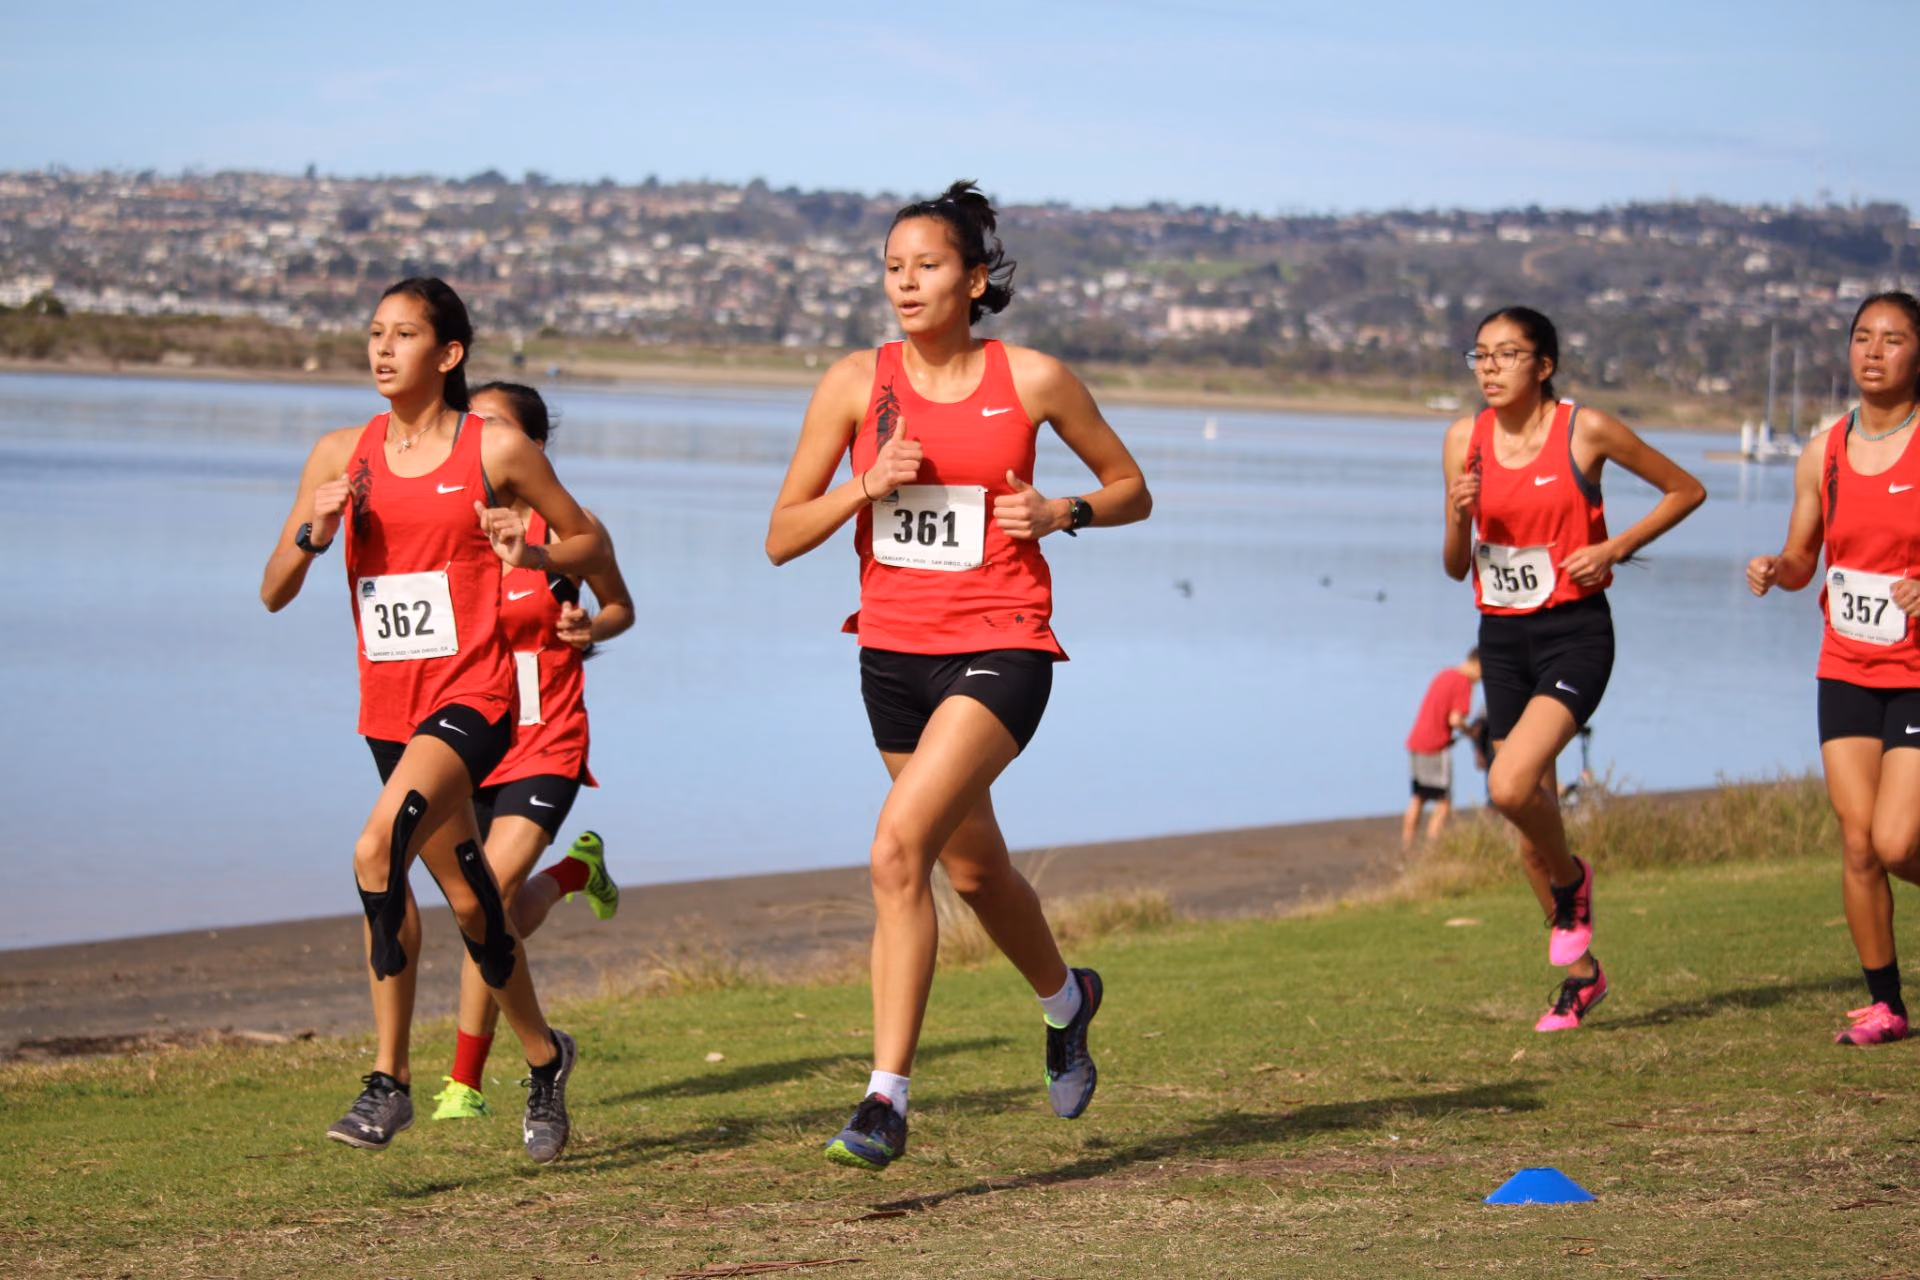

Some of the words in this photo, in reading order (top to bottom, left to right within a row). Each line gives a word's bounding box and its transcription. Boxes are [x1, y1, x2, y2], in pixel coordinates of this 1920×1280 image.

[893, 509, 959, 547] 361
[1489, 564, 1538, 593] 356
[374, 600, 435, 639] 362
[1842, 592, 1889, 626] 357
